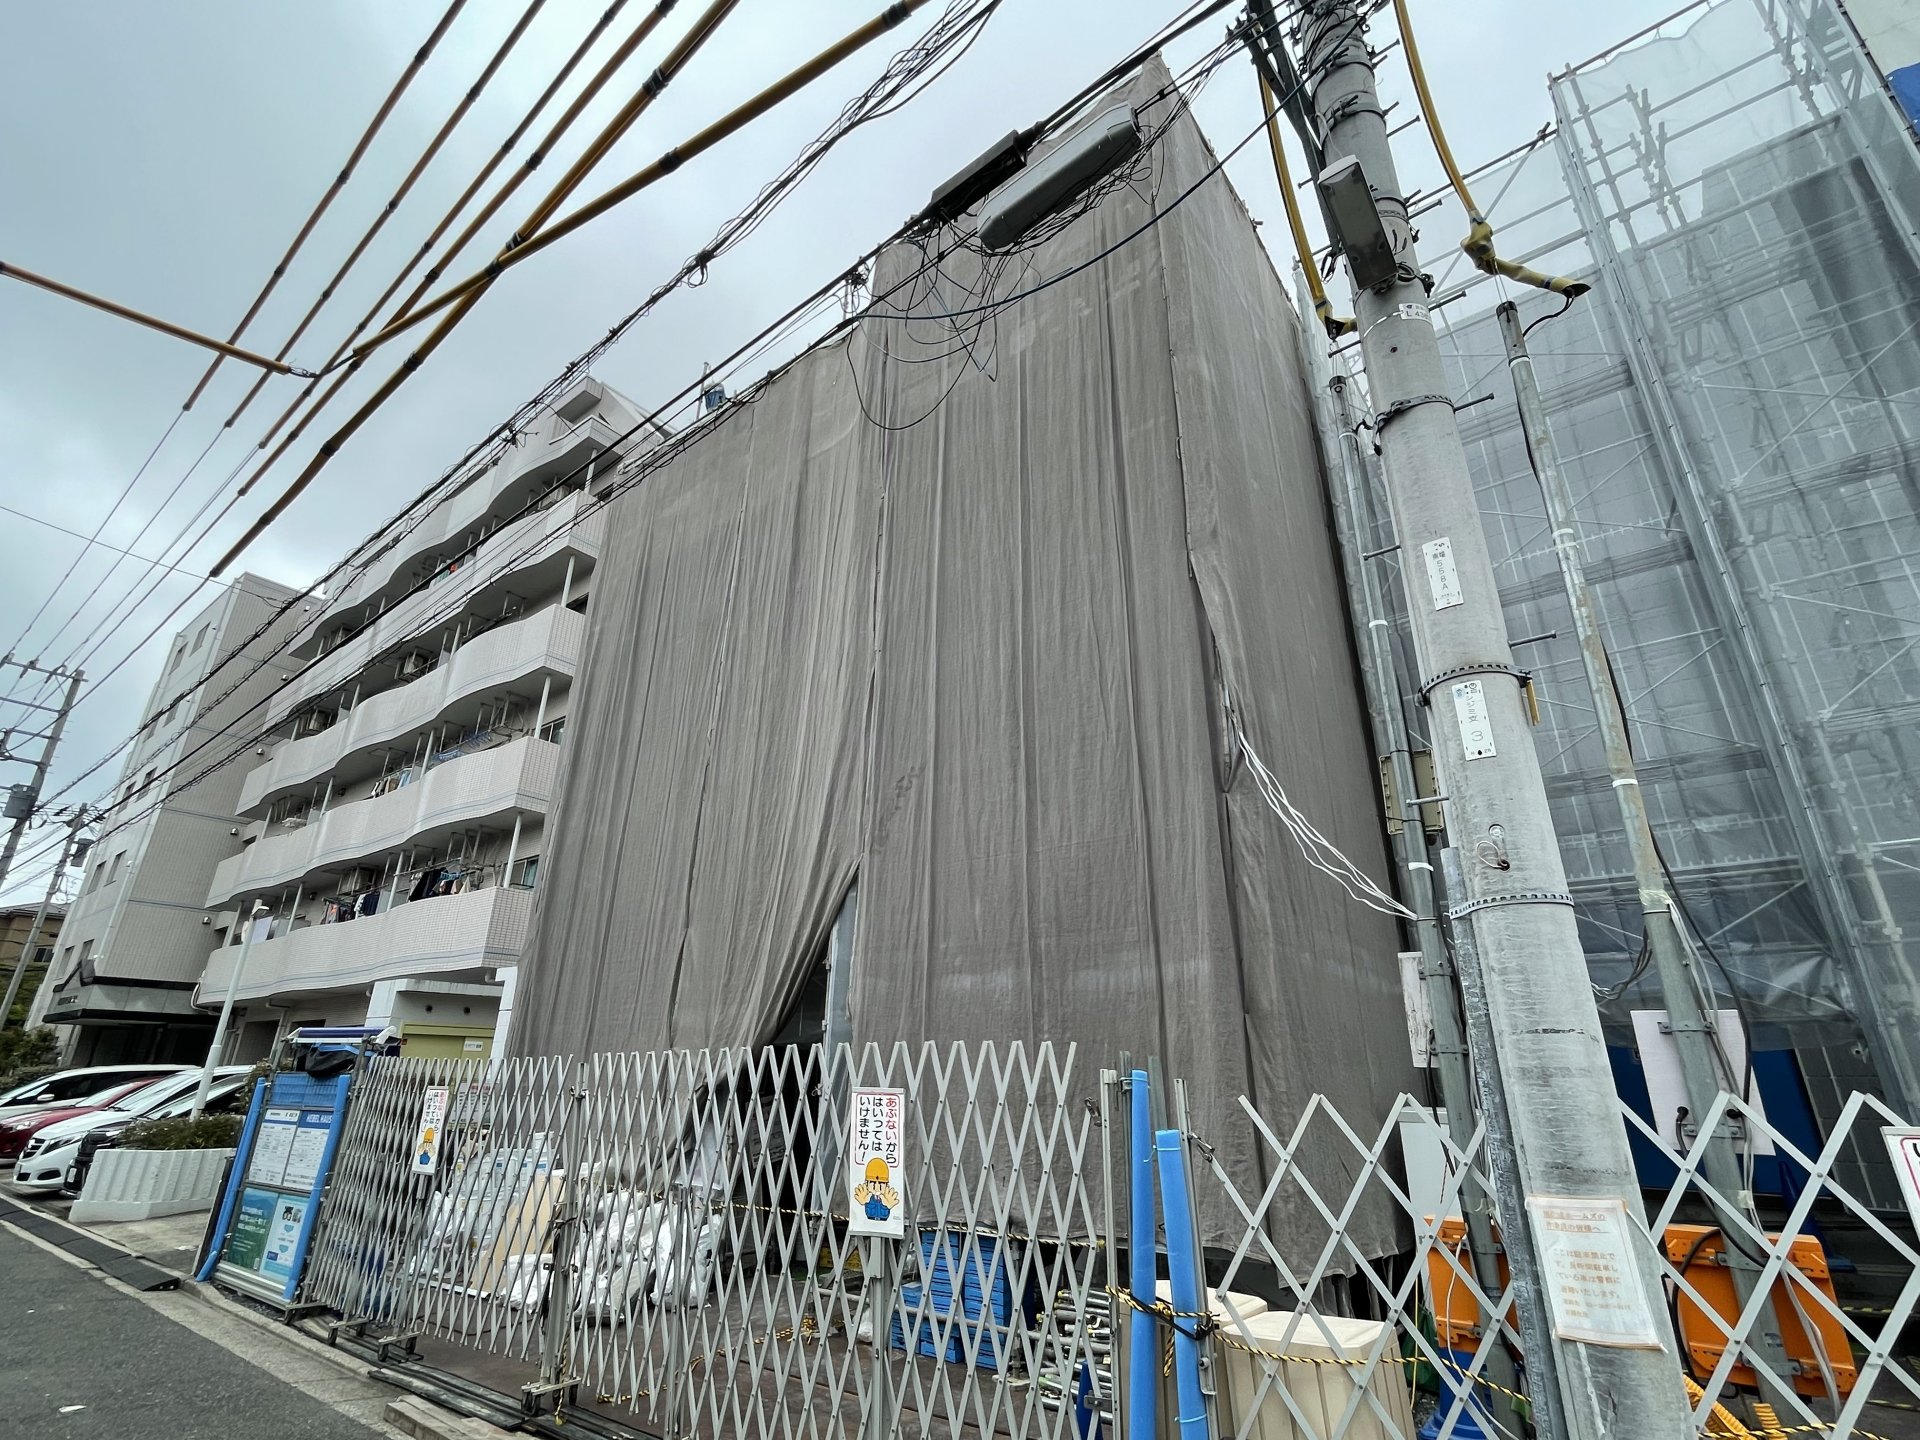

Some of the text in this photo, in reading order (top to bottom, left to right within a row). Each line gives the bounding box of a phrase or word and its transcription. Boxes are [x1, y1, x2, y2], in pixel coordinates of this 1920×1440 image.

[858, 1096, 871, 1163] いけません！
[871, 1096, 884, 1152] はいっては
[885, 1096, 898, 1165] あぶないから
